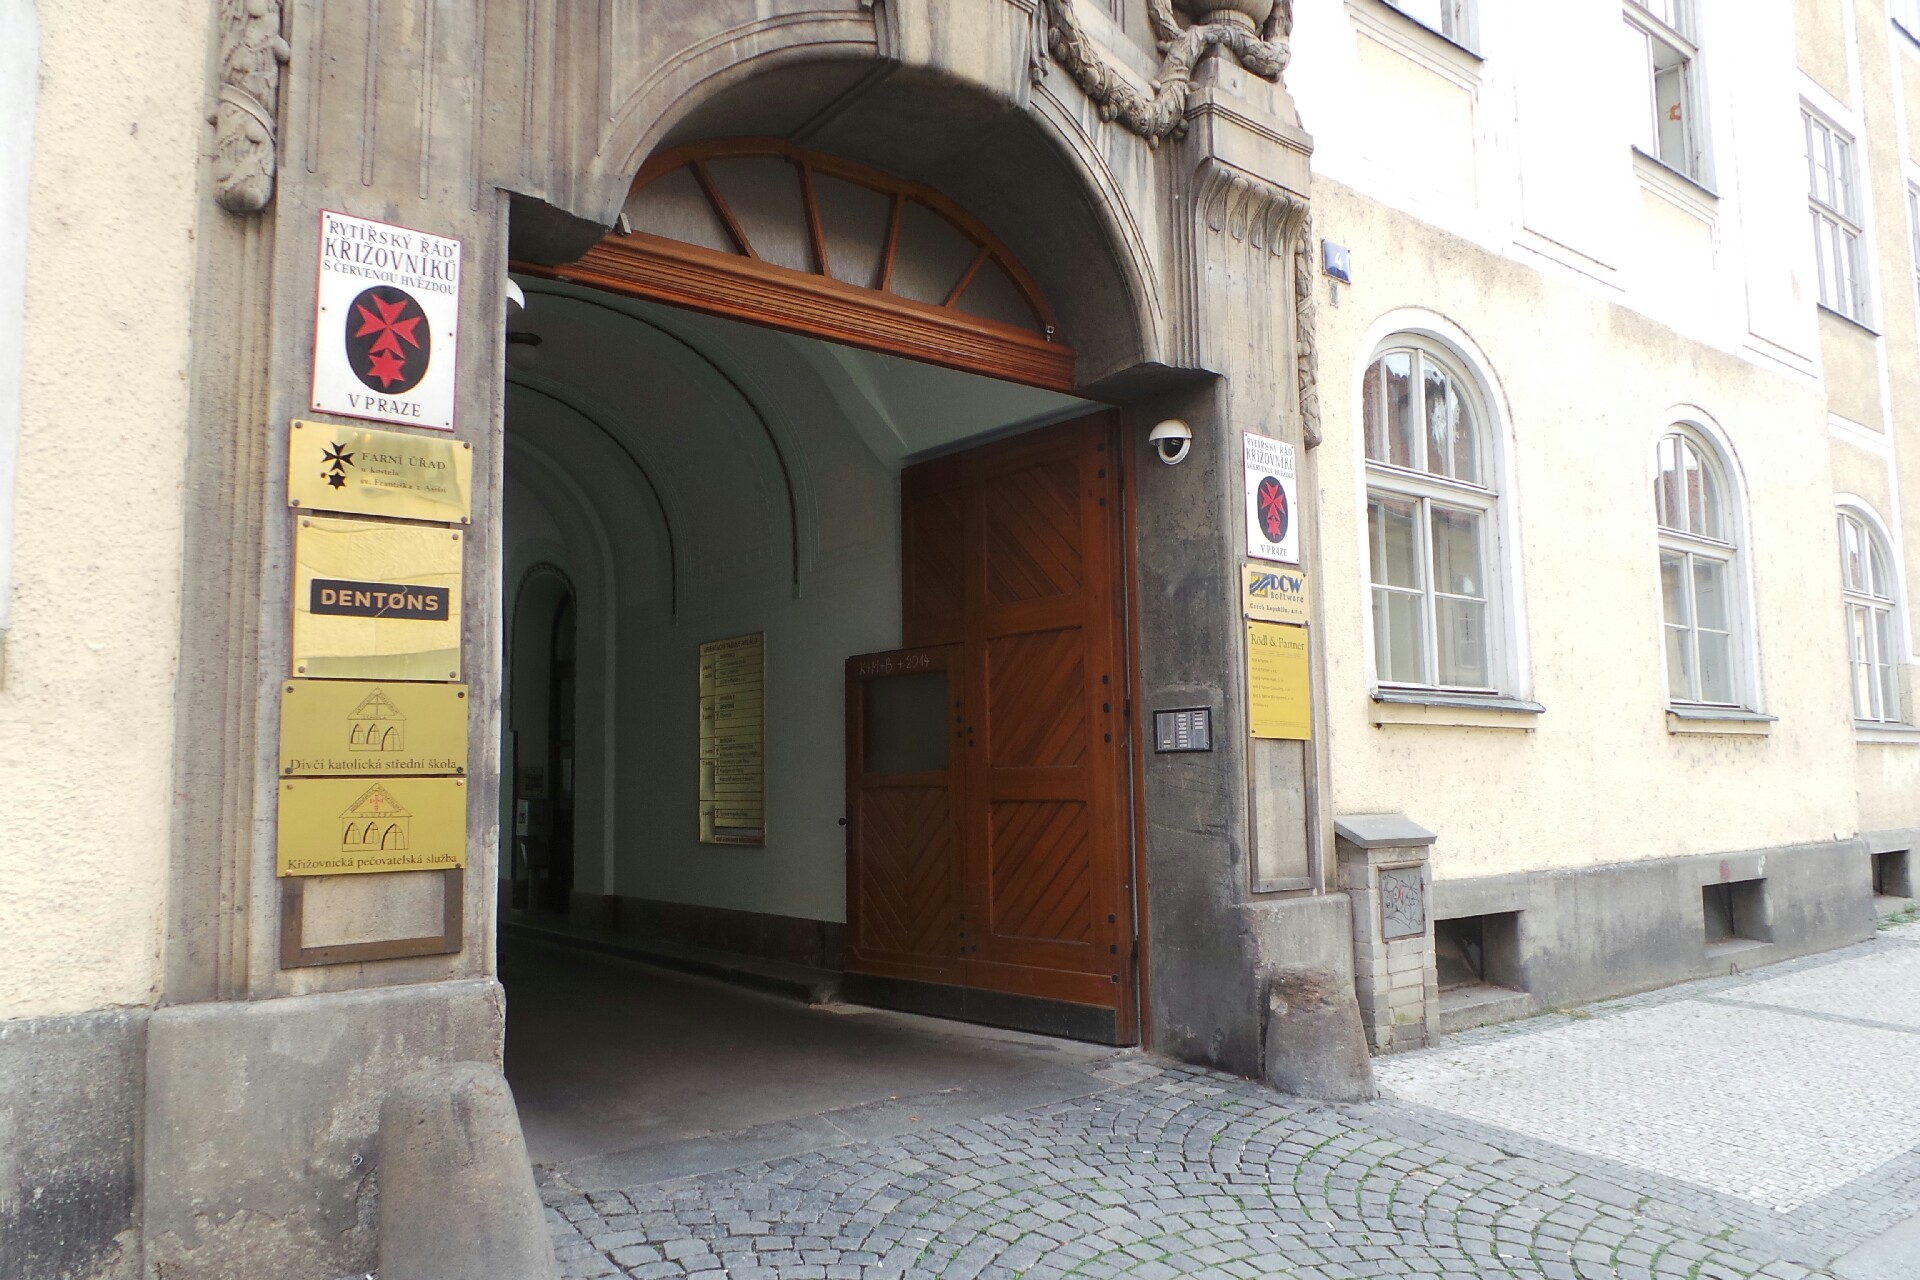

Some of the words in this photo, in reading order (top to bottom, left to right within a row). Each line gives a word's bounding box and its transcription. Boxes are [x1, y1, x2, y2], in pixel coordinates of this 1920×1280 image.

[329, 220, 413, 249] RYTÍŘSKÝ
[420, 237, 453, 258] ŘÁD
[324, 236, 457, 281] KŘIŽOVNÍKŮ
[1334, 252, 1344, 271] 4
[323, 259, 331, 270] S
[333, 259, 399, 284] ČERVENOU
[400, 275, 456, 295] HVĚZDOU
[347, 393, 359, 408] V
[365, 396, 421, 418] PRAZE
[361, 452, 403, 466] FARNÍ
[408, 455, 447, 470] ÚŘAD
[370, 465, 400, 477] kostela
[1266, 545, 1288, 557] PRAZE
[320, 588, 439, 611] DENTONS
[1270, 591, 1304, 603] Software
[1269, 636, 1277, 648] &
[1278, 636, 1304, 650] Partner
[906, 653, 930, 669] 2014
[290, 758, 325, 770] Dívčí
[327, 758, 382, 770] katolická
[385, 758, 425, 770] střední
[428, 758, 456, 769] škola
[356, 854, 423, 869] pečovatelská
[426, 853, 457, 865] služba
